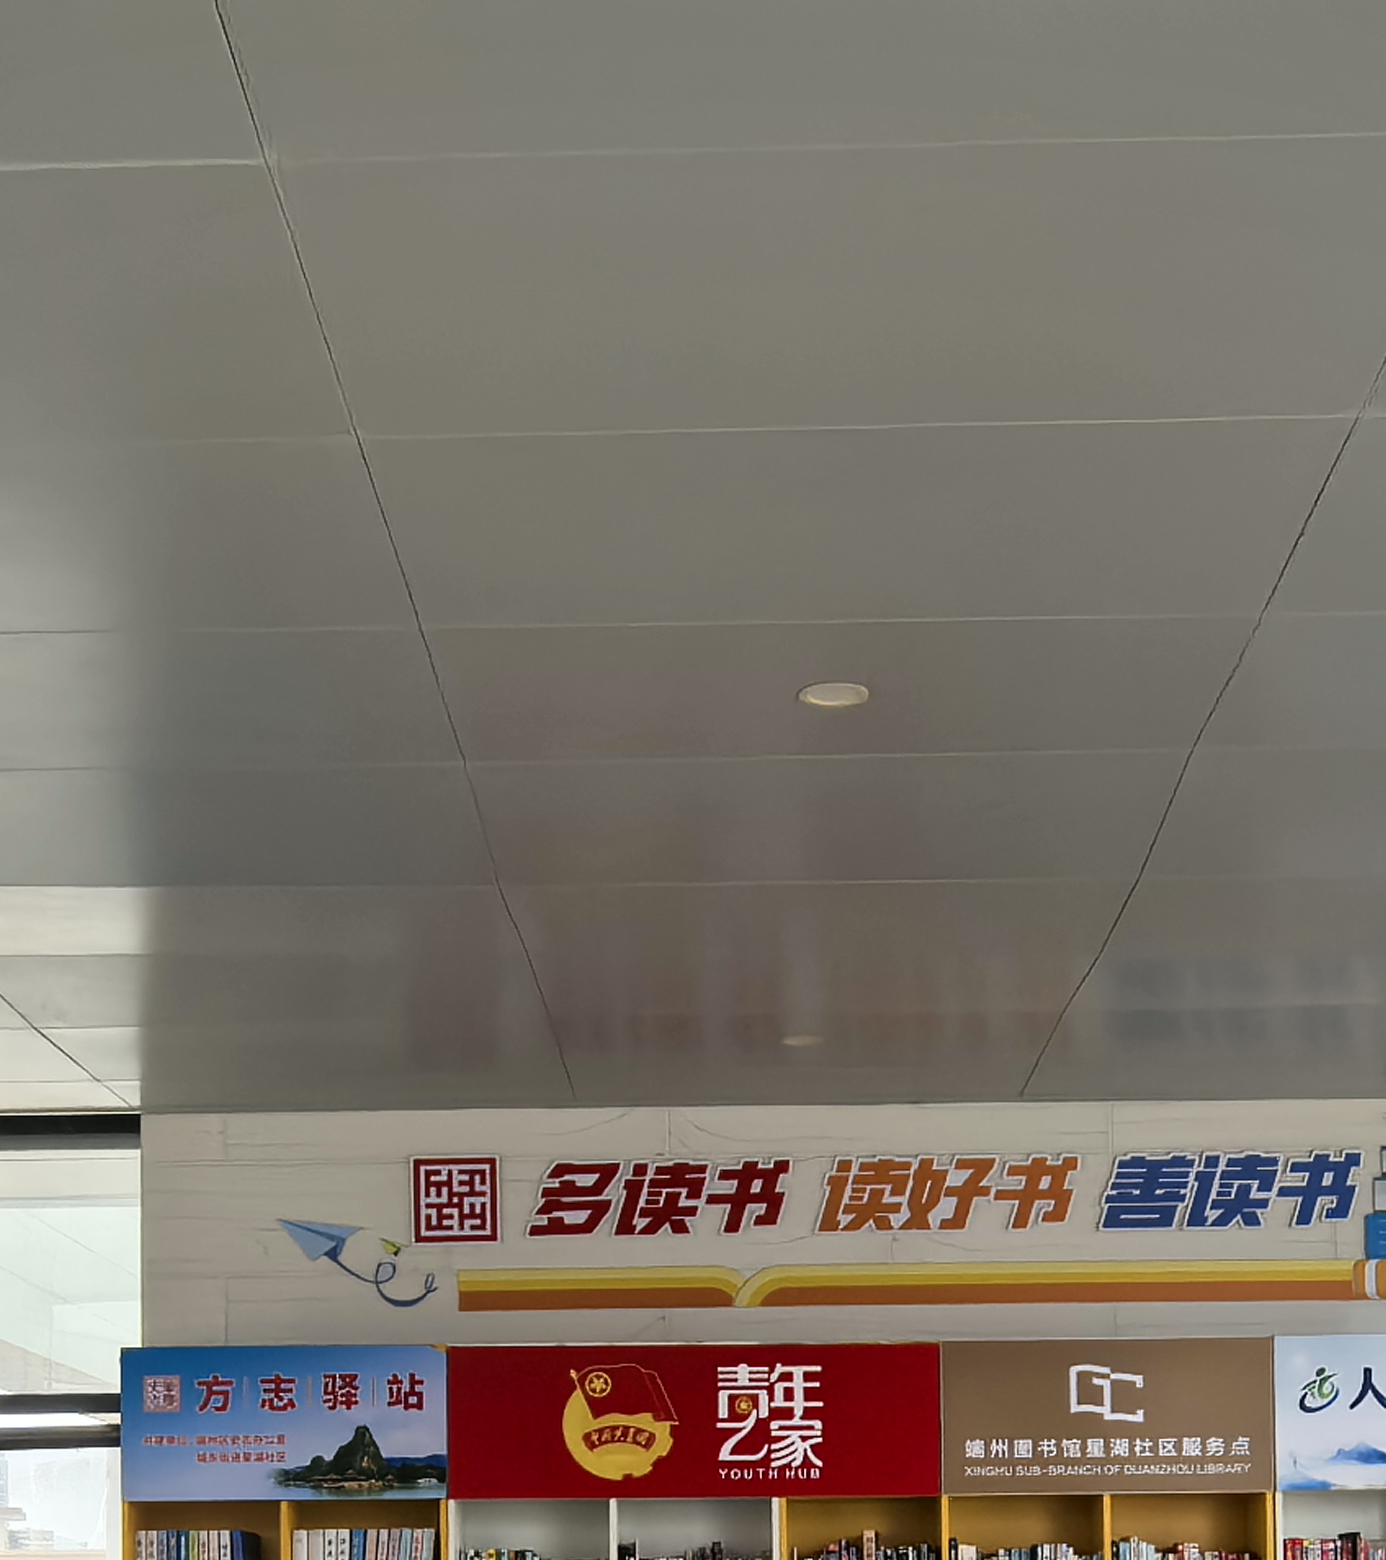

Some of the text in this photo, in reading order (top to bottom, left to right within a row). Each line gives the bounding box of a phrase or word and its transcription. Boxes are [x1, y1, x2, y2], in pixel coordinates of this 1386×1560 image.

[526, 1158, 792, 1237] 多读书
[816, 1155, 1079, 1232] 读好书
[1101, 1151, 1364, 1229] 善读书
[195, 1371, 426, 1413] 方志驿站
[716, 1363, 824, 1421] 青年
[964, 1436, 1252, 1459] 端州图书馆星湖社区服务点
[718, 1467, 820, 1480] YOUTH HUB
[1103, 1464, 1122, 1476] OF
[1196, 1462, 1252, 1475] LIBRARY
